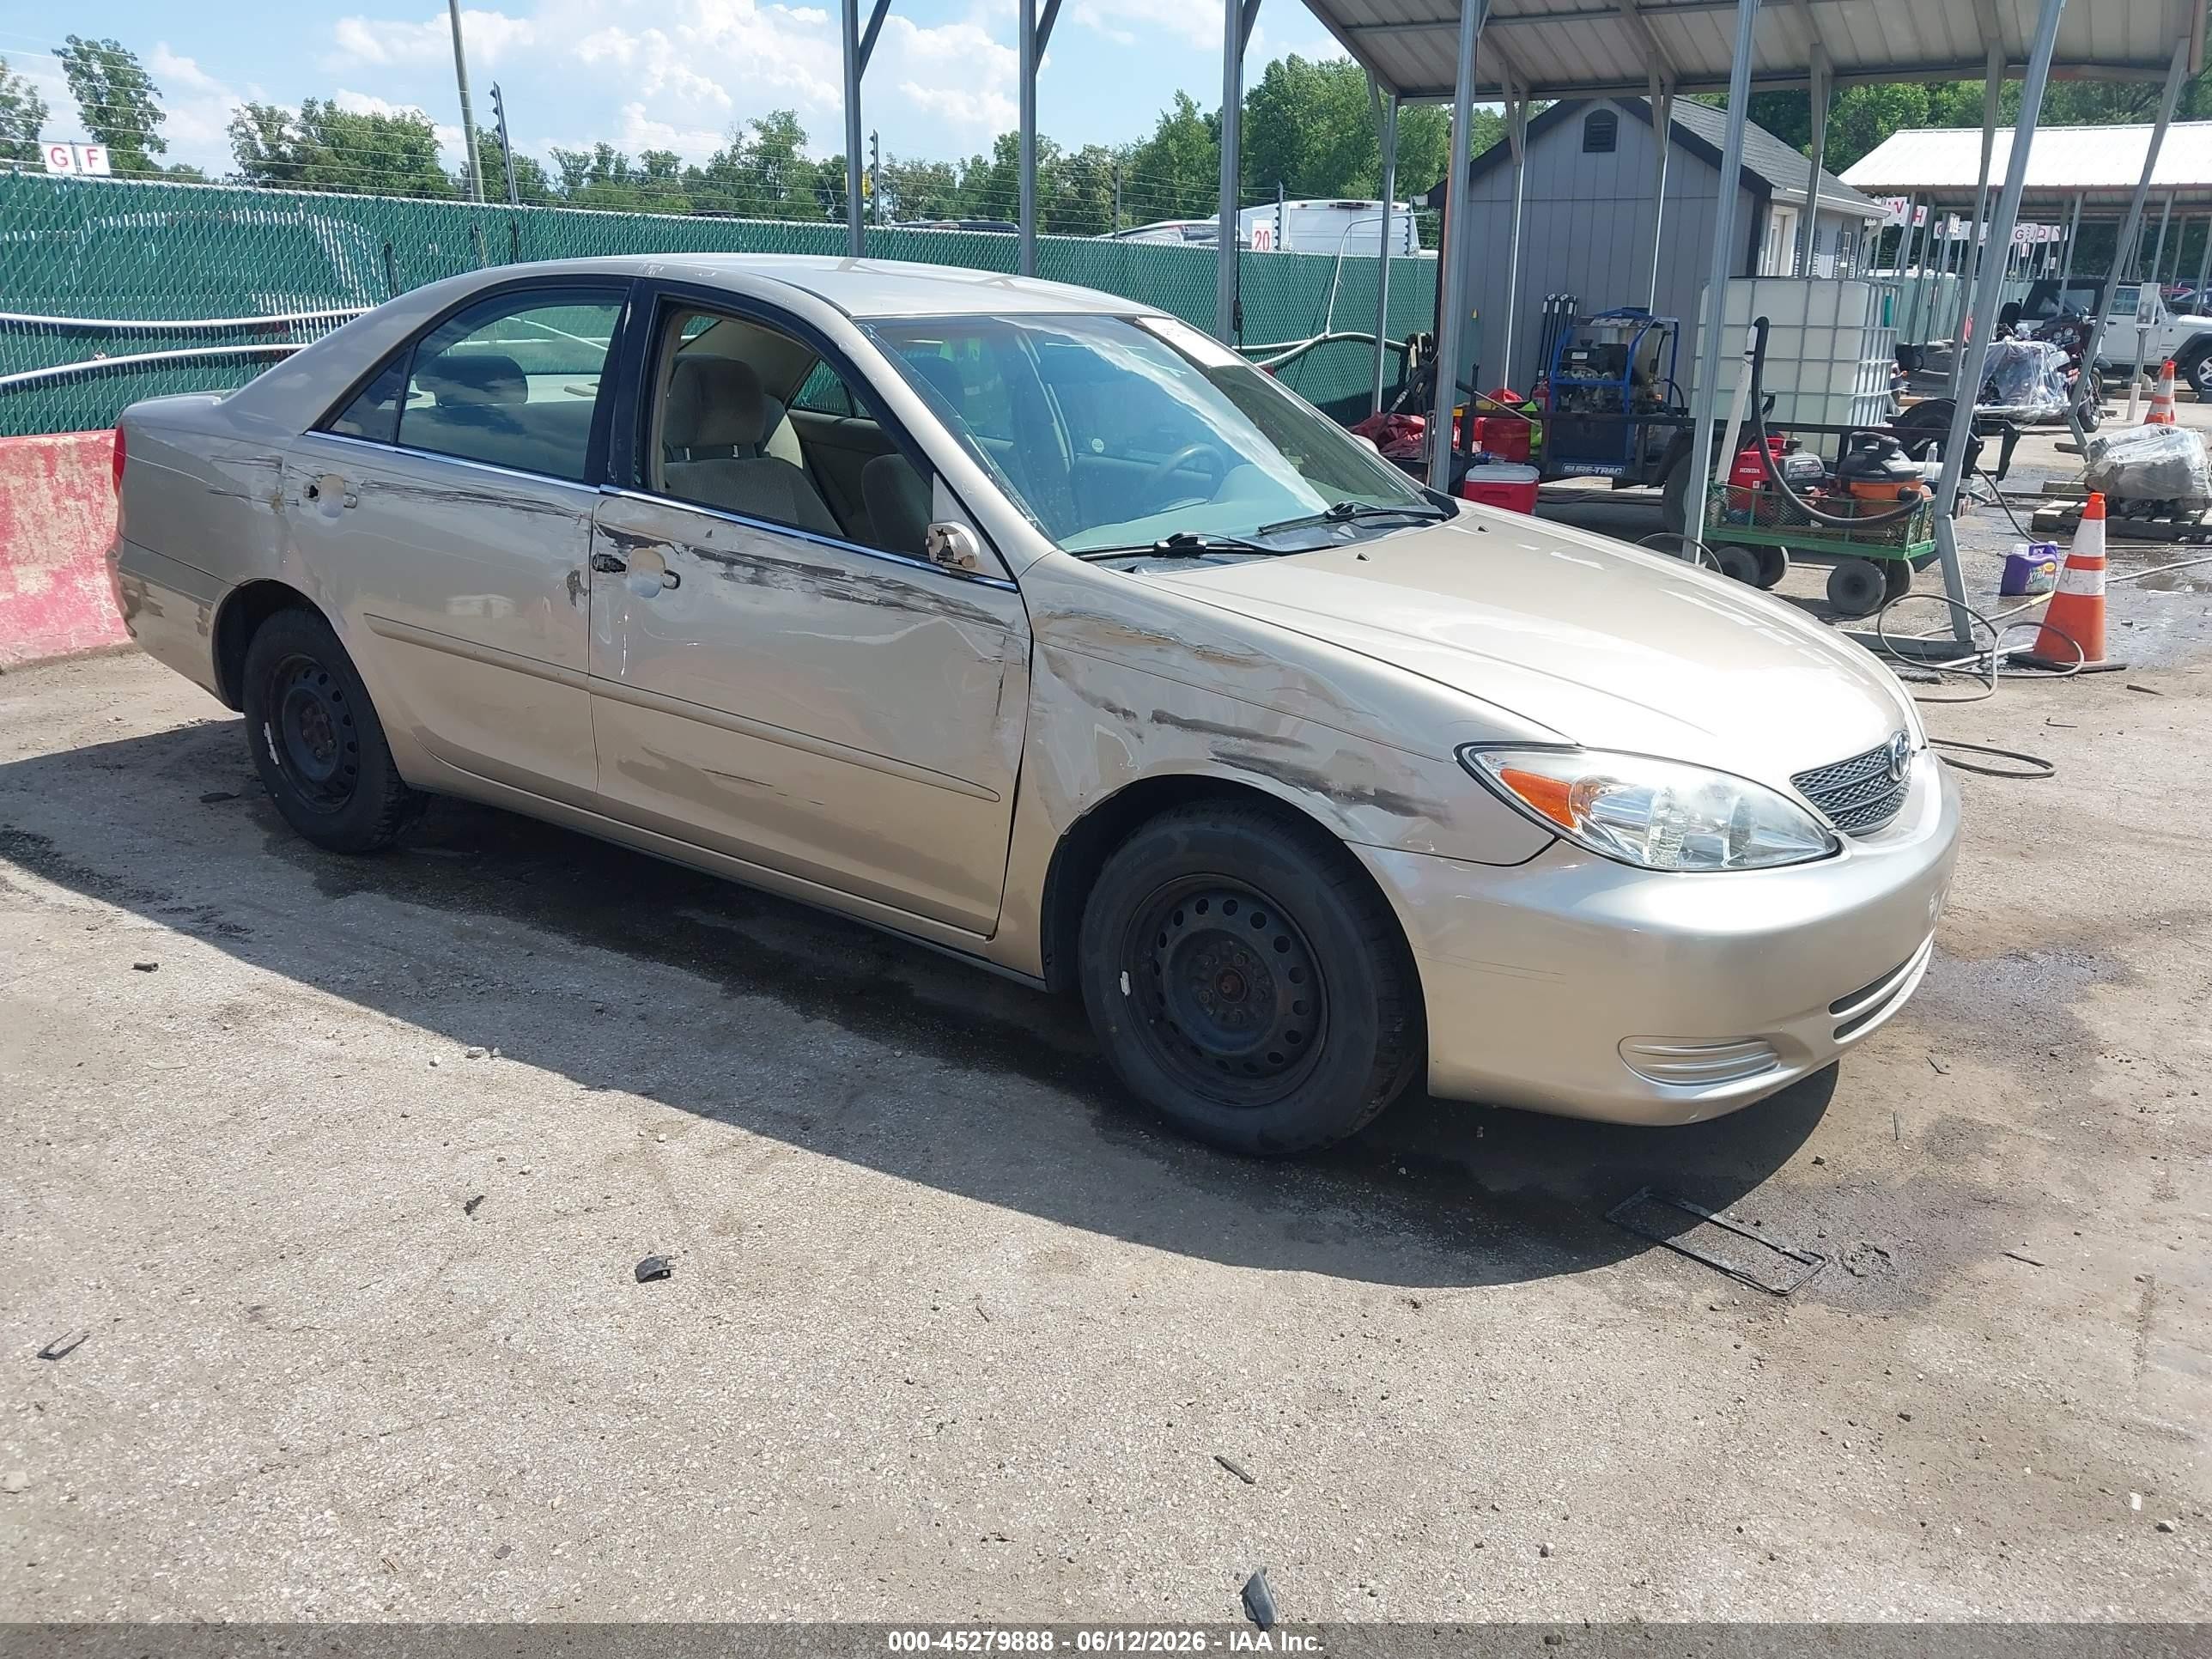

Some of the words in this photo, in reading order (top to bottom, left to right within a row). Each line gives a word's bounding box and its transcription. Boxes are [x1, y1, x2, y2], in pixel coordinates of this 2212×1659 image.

[51, 147, 69, 167] G
[87, 149, 99, 168] F
[1255, 230, 1270, 251] 20
[2014, 229, 2024, 240] G
[1564, 465, 1623, 475] SURE-TRAC
